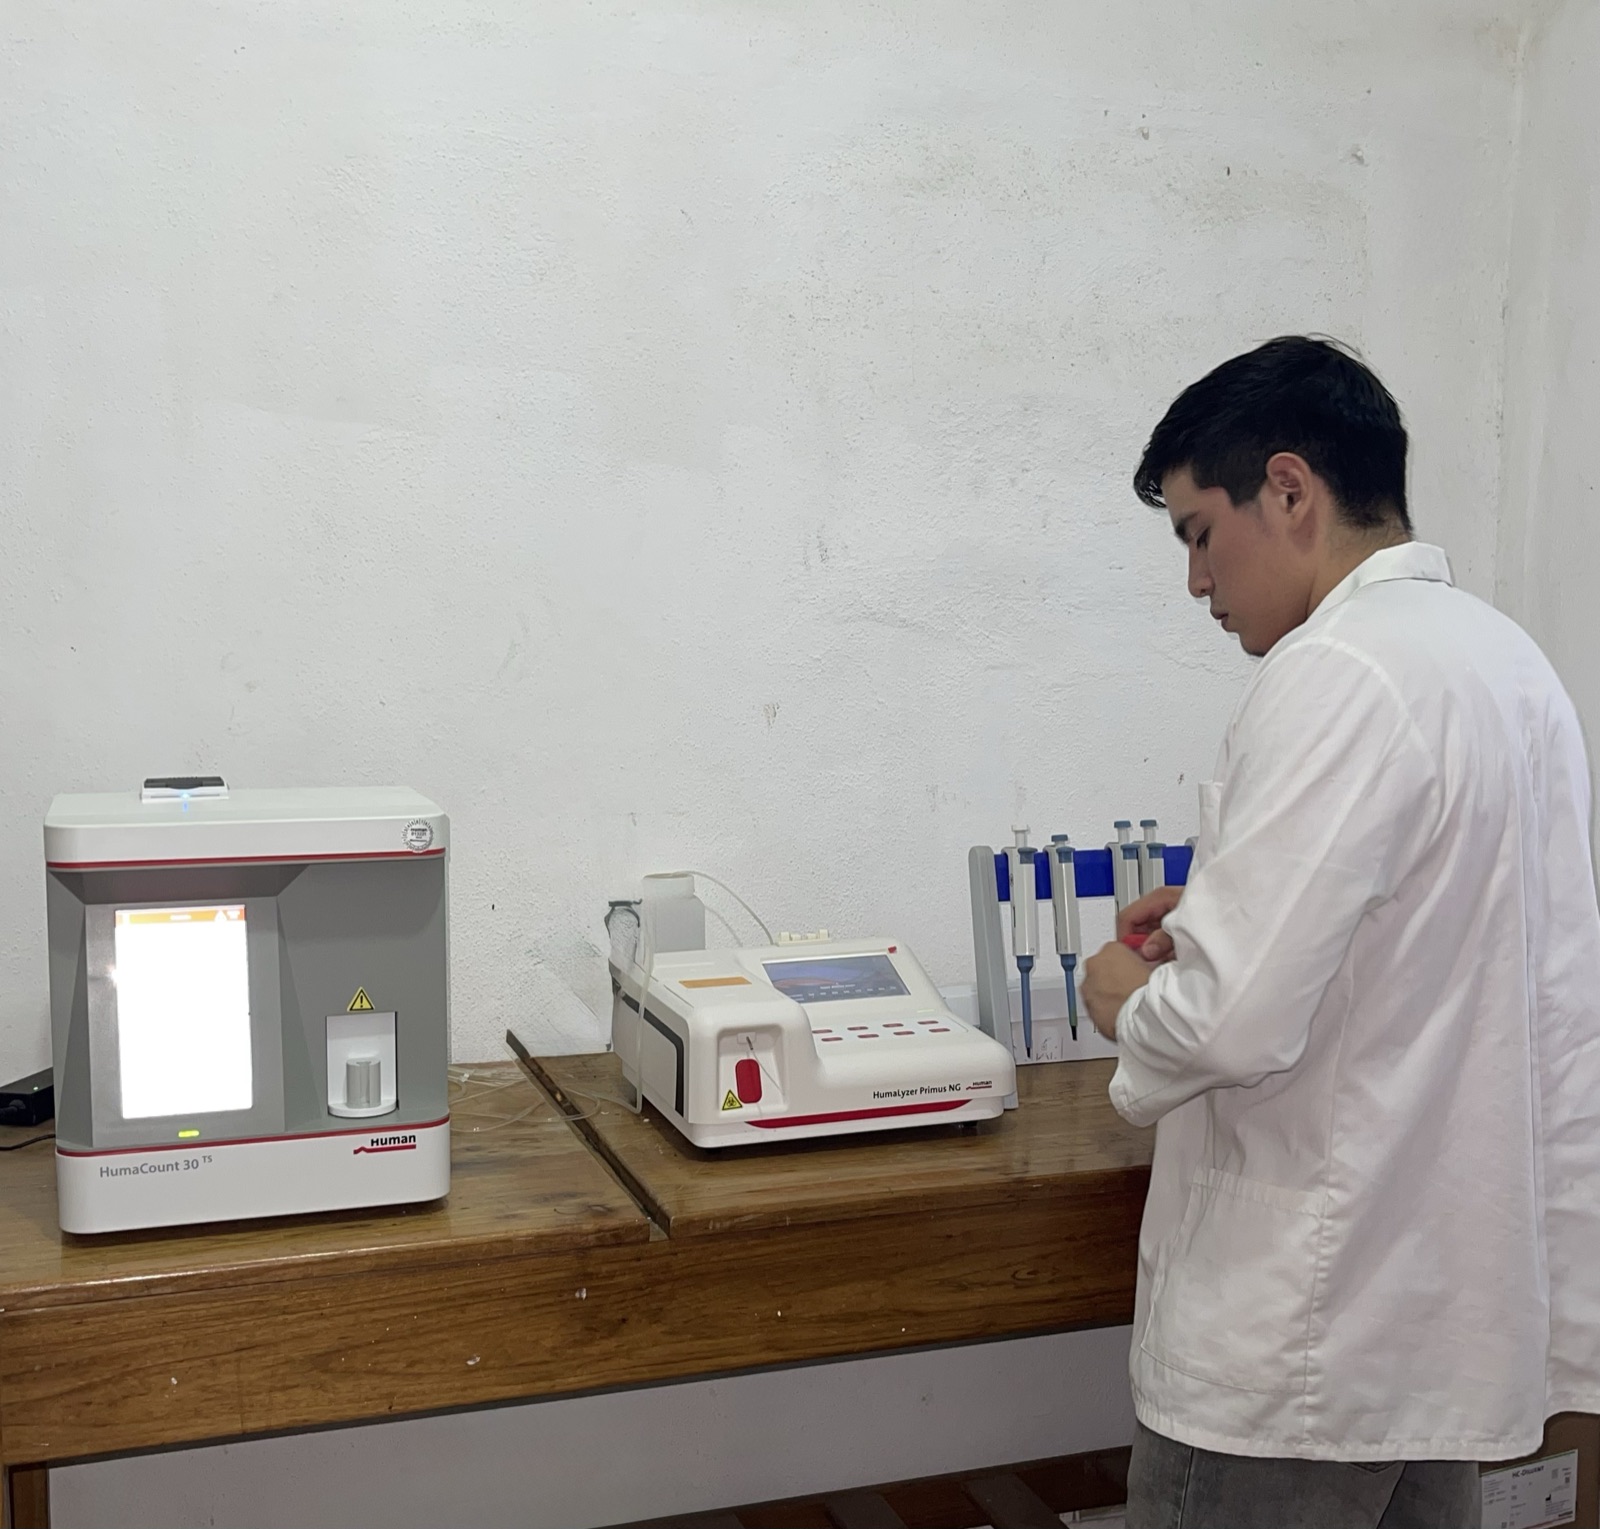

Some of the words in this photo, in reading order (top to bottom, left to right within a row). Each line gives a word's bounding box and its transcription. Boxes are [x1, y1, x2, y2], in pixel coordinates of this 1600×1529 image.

[920, 1085, 947, 1095] Primus
[949, 1083, 961, 1092] NG
[100, 1161, 180, 1178] HumaCount
[183, 1158, 200, 1171] 30
[202, 1155, 213, 1163] TS
